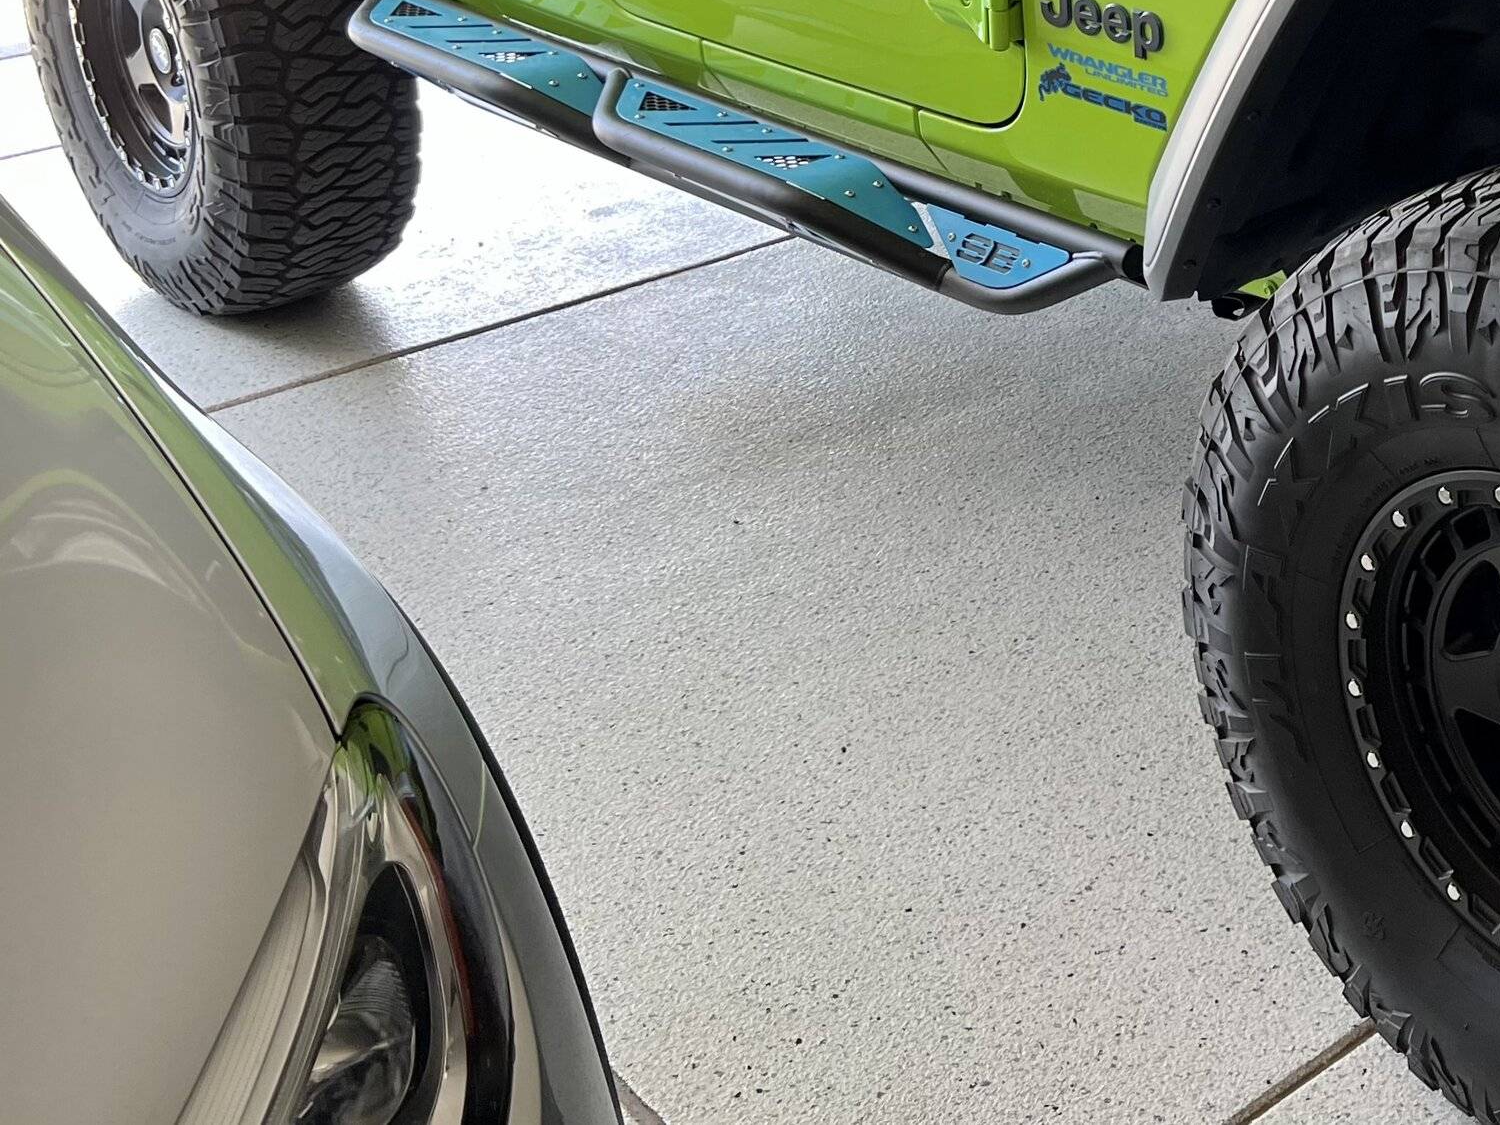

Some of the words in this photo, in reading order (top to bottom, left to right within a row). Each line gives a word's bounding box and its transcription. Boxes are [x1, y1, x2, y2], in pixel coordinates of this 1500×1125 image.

[1047, 41, 1168, 91] WRANGLER
[1084, 67, 1168, 98] UNLIMITED
[1062, 81, 1168, 124] GECKO
